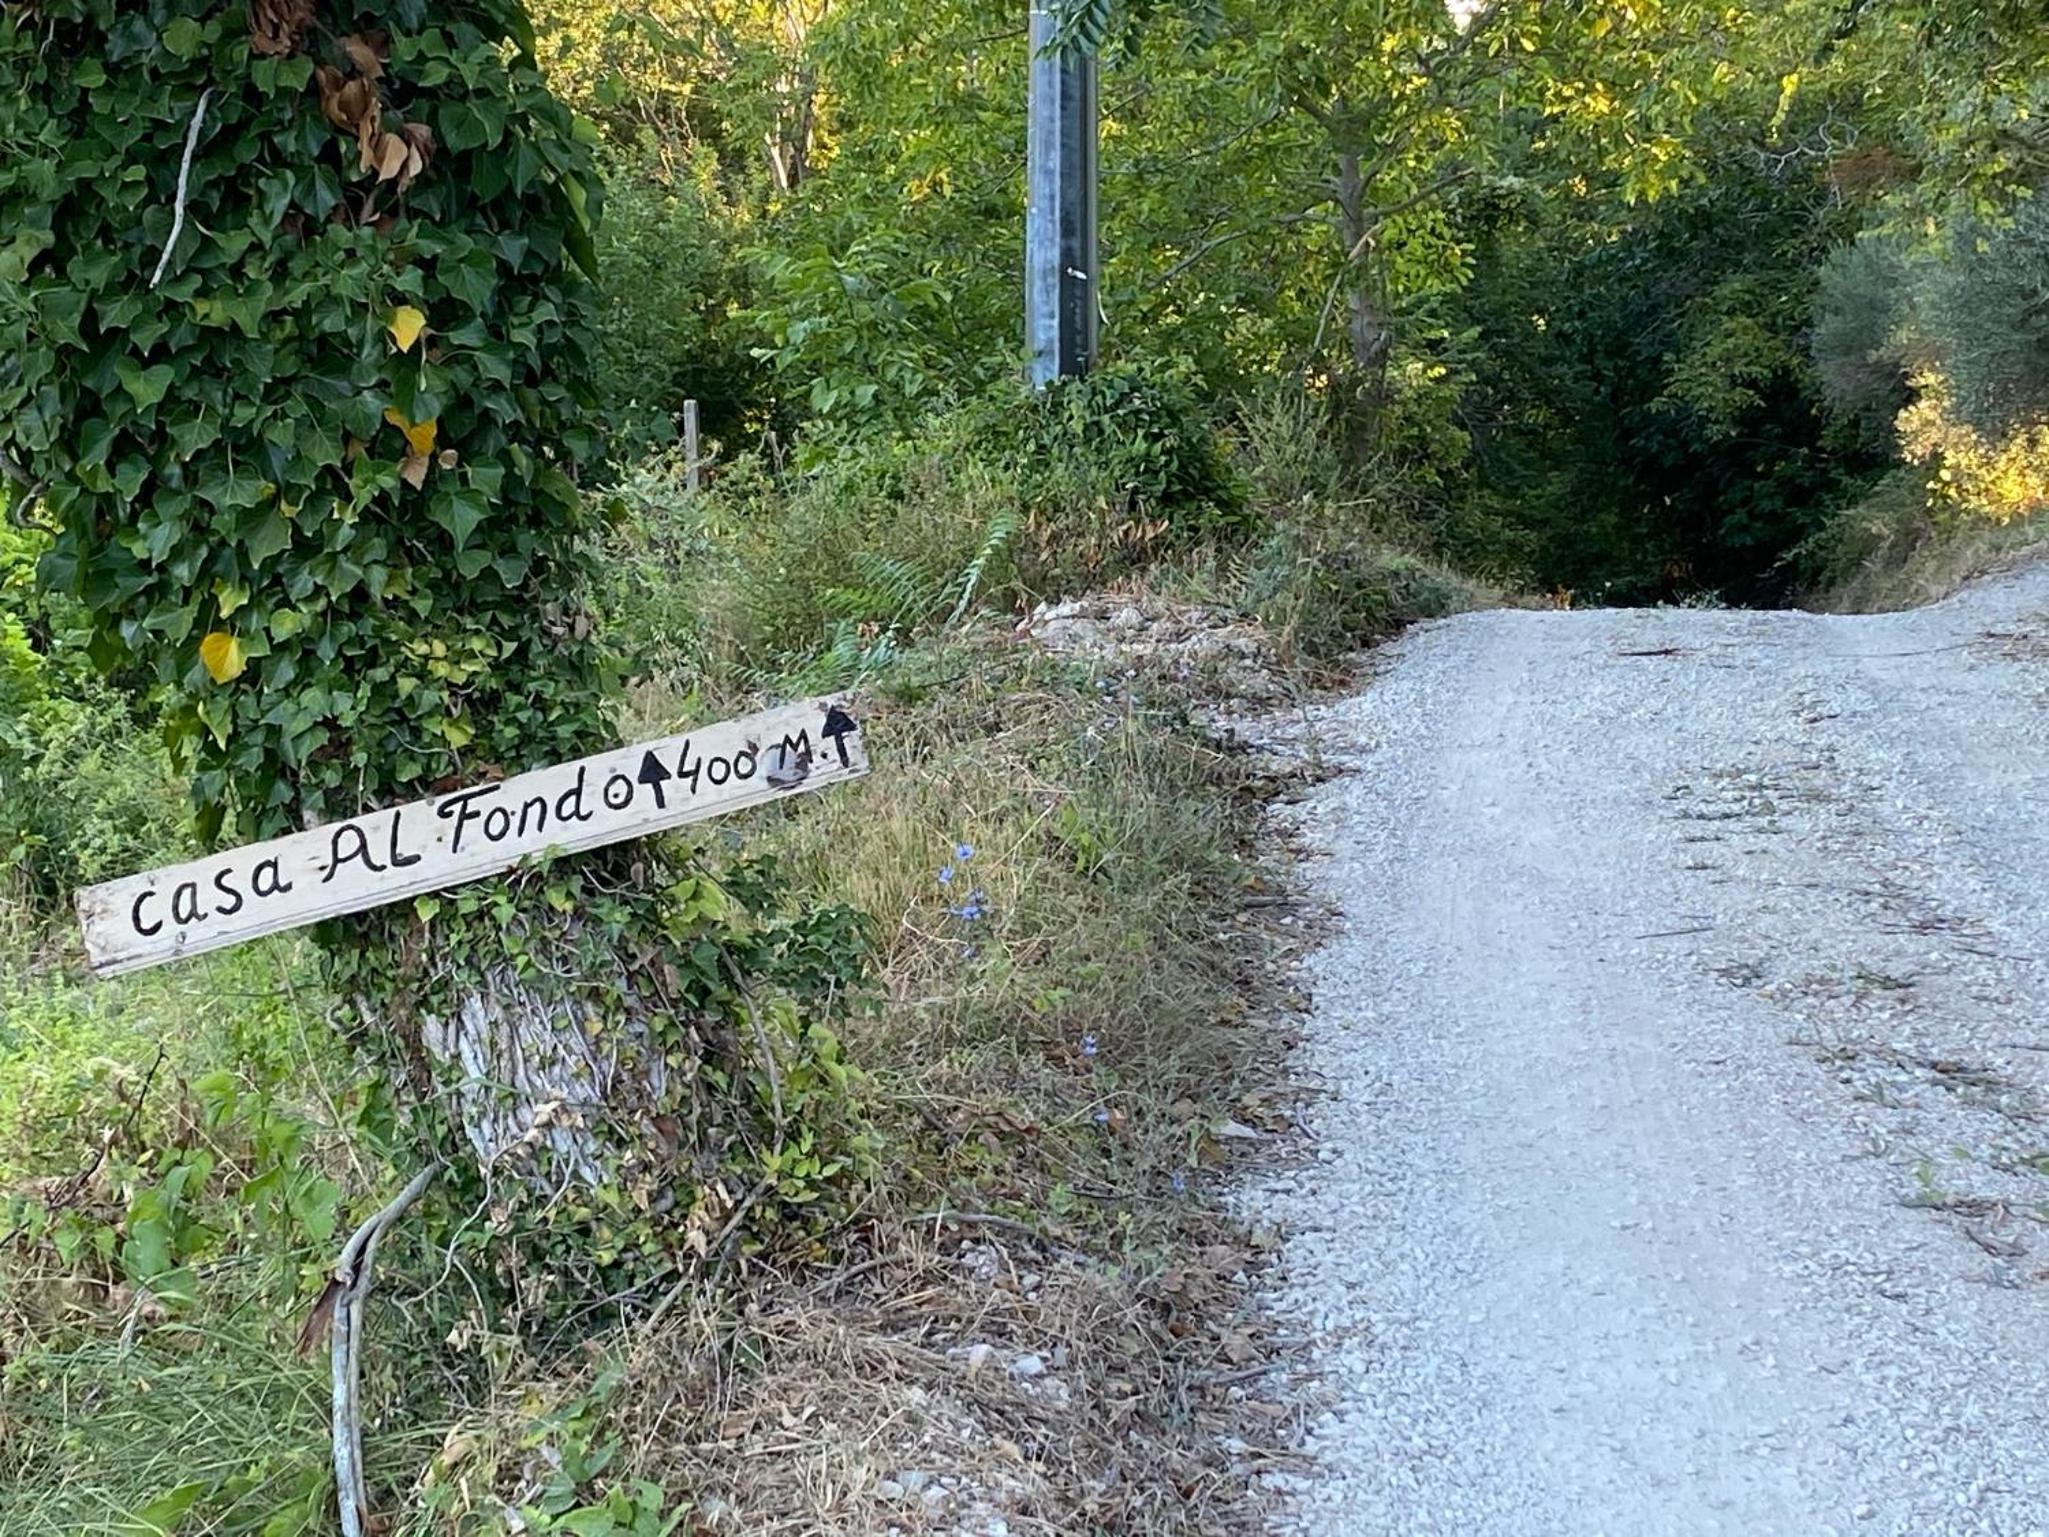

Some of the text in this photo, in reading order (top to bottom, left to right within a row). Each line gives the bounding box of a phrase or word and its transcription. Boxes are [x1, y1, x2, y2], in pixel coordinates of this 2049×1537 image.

[321, 809, 421, 883] AL
[437, 766, 634, 853] Fondo
[677, 739, 757, 795] 400
